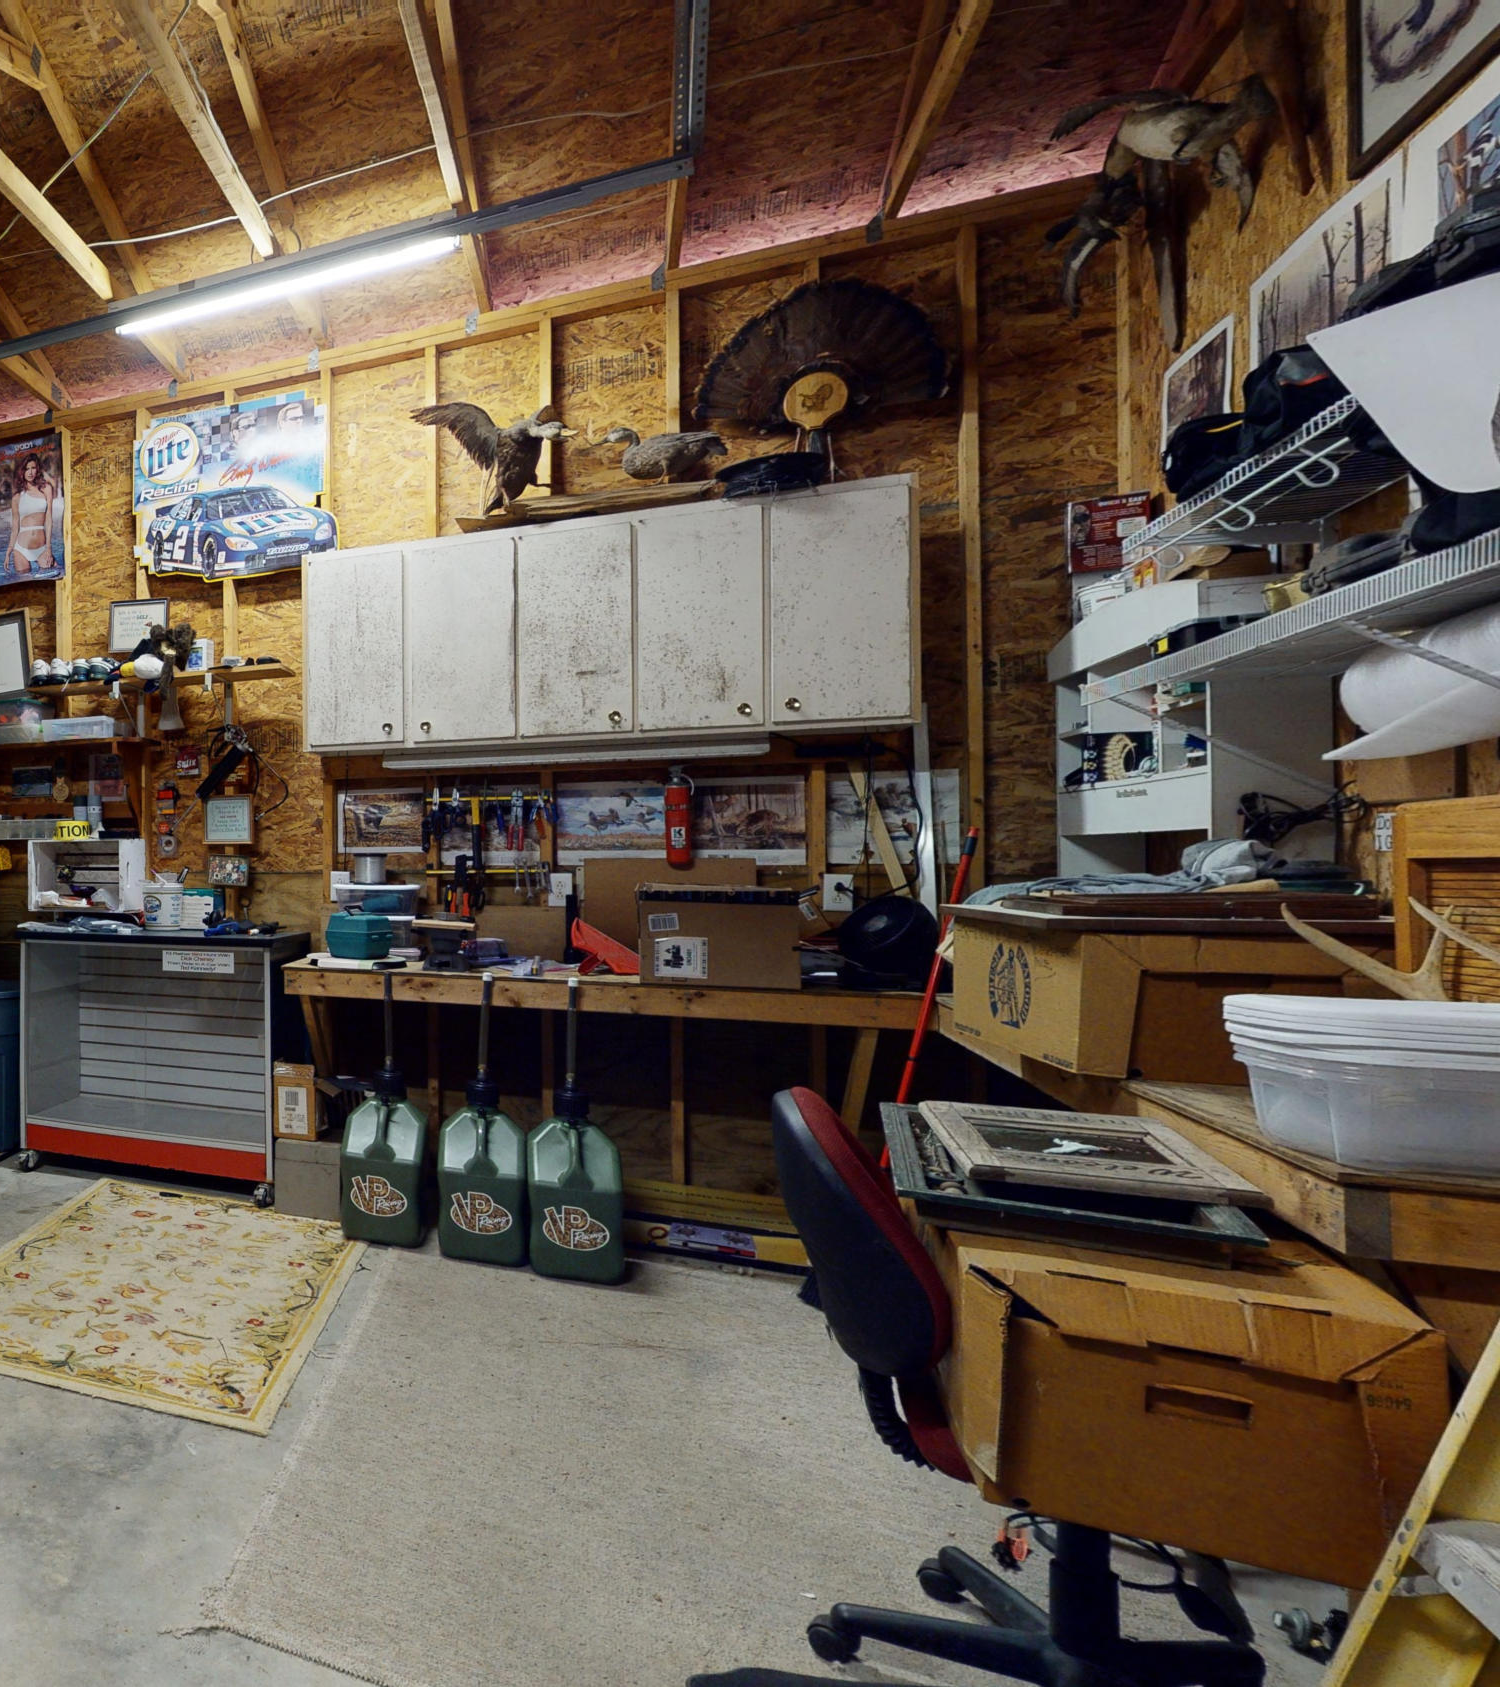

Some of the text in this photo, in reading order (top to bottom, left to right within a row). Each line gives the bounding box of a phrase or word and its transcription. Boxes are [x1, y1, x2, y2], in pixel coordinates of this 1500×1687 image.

[153, 430, 181, 449] Miller
[148, 438, 189, 478] Lite
[140, 481, 198, 503] Racing
[173, 525, 189, 561] 2
[54, 824, 89, 838] TION
[352, 1175, 391, 1215] VP
[451, 1191, 494, 1233] VP
[478, 1215, 511, 1228] Racing
[543, 1205, 591, 1249] VP
